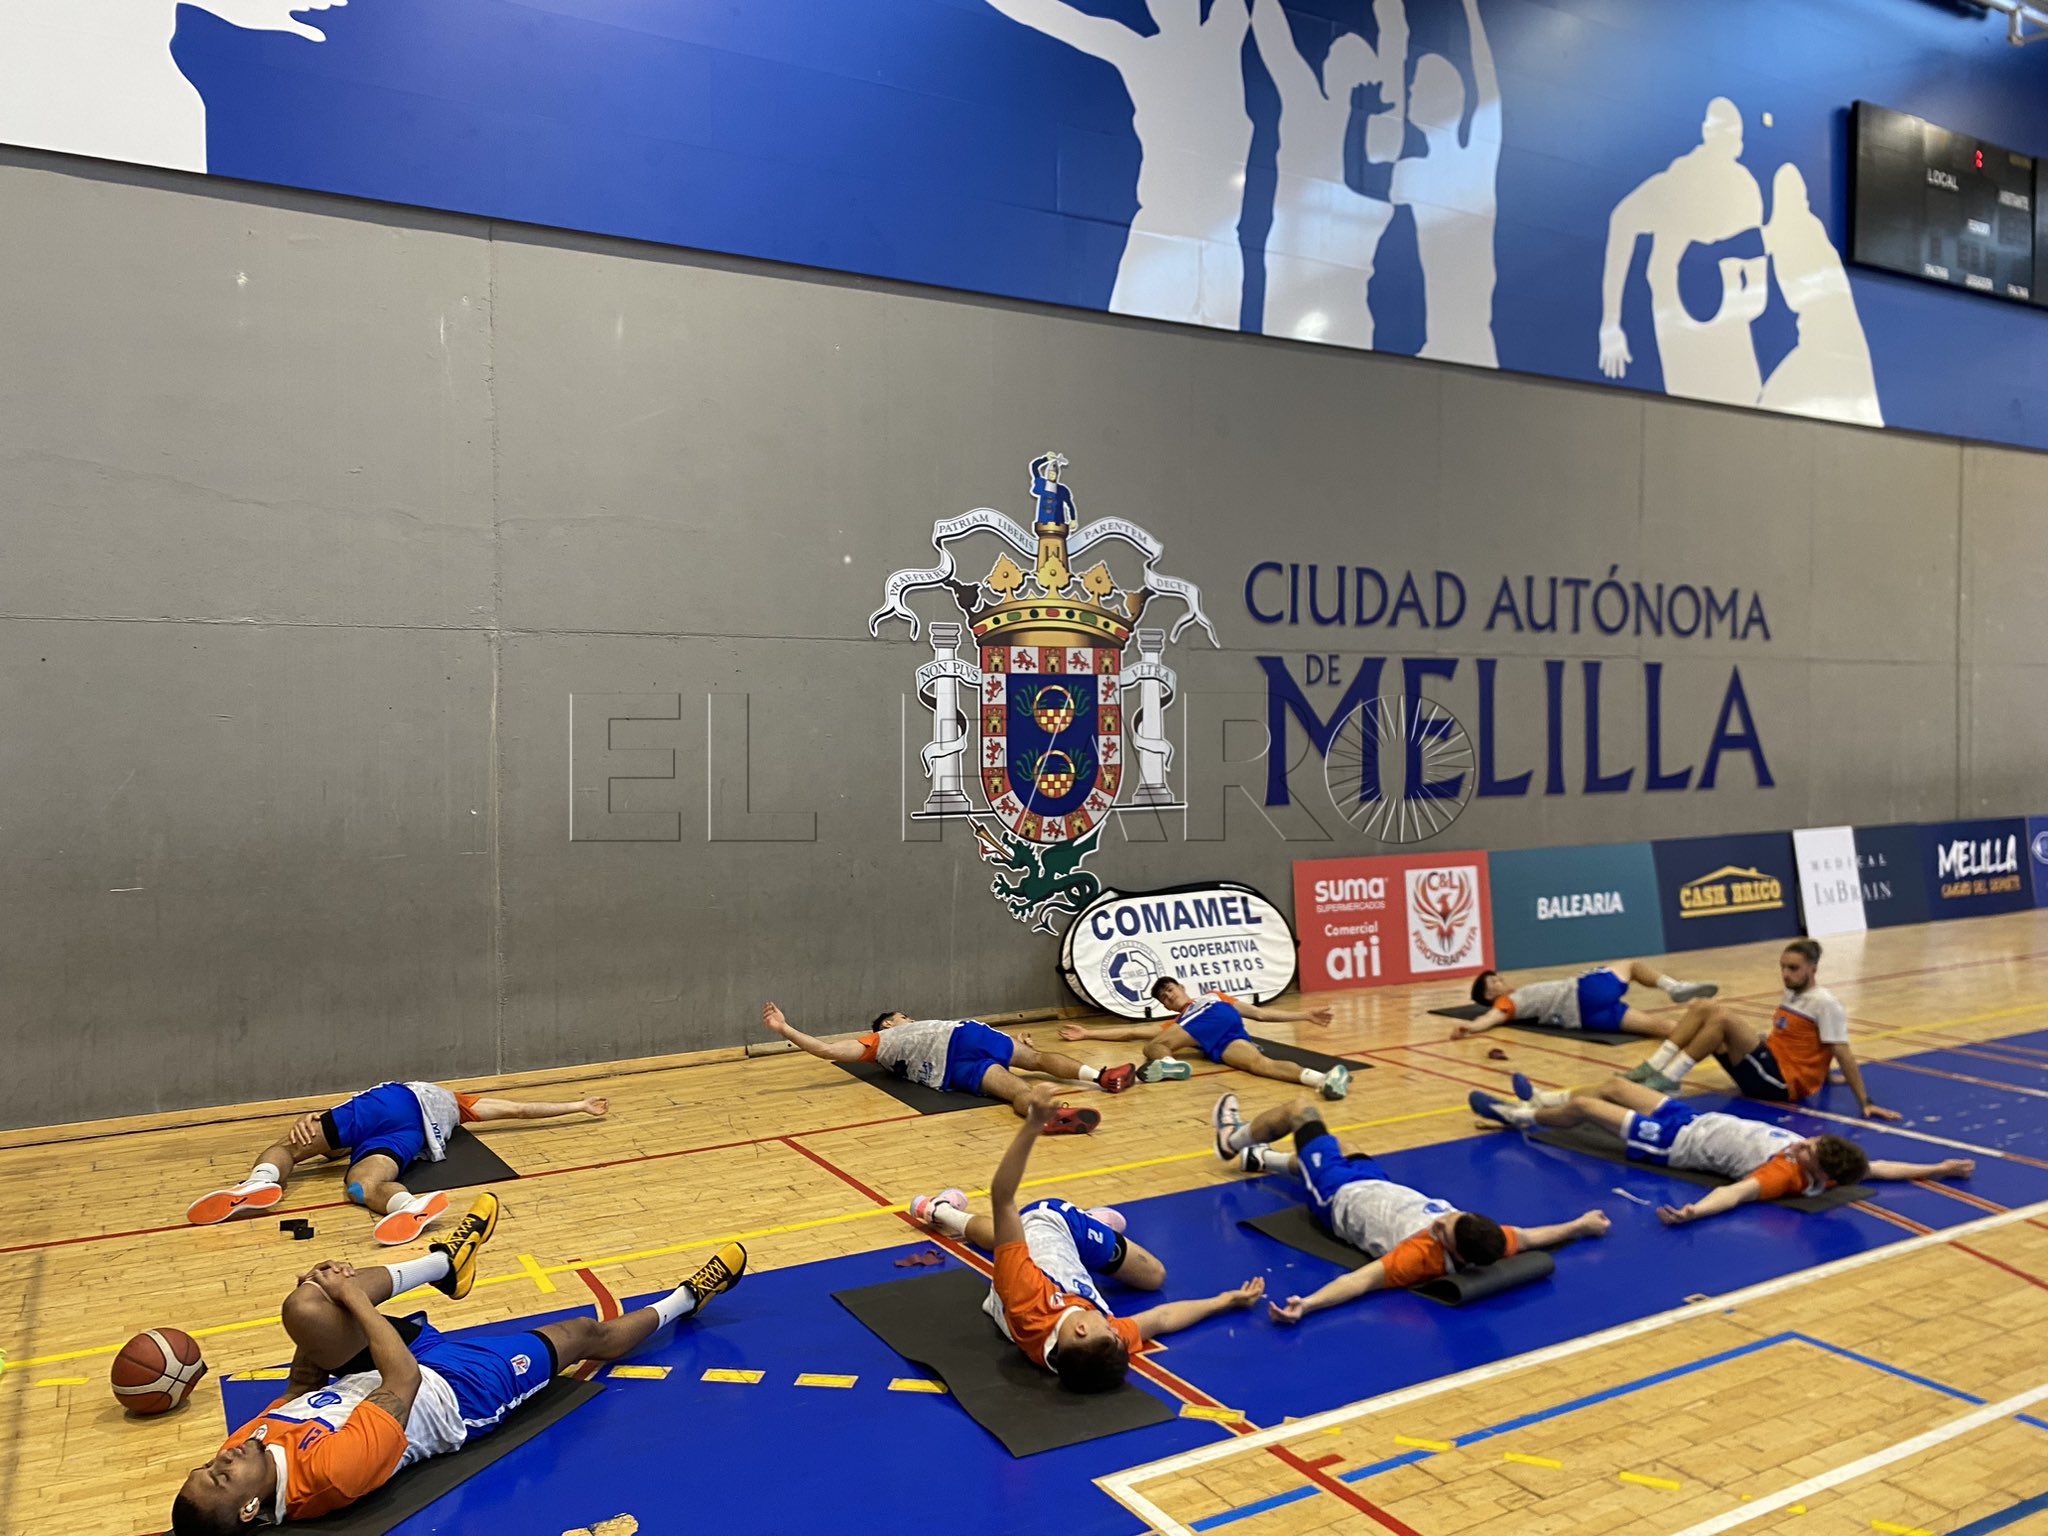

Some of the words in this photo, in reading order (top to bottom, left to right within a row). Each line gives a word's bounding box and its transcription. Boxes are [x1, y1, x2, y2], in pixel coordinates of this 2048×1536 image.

[1926, 168, 1959, 191] LOCAL
[938, 512, 989, 534] PATRIAM
[998, 518, 1034, 551] LIBERIS
[1084, 521, 1148, 545] PARENTEM
[890, 567, 949, 597] PRAEFERRE
[1156, 578, 1191, 593] DECET
[1244, 562, 1467, 629] CIUDAD
[1485, 565, 1772, 640] AUTÓNOMA
[920, 662, 948, 682] NON
[953, 662, 979, 680] PLVS
[1305, 654, 1340, 686] DE
[1256, 655, 1775, 806] MELILLA
[1937, 833, 2018, 880] MELILLA
[1315, 877, 1386, 903] suma
[1680, 884, 1727, 909] CASH
[1731, 878, 1781, 904] BRICO
[1091, 896, 1263, 940] COMAMEL
[1316, 900, 1386, 913] SUPERMERCADOS
[1324, 921, 1379, 937] Comercial
[1171, 939, 1260, 960] COOPERATIVA
[1326, 935, 1381, 980] ati
[1412, 926, 1478, 967] FISIOTERAPEUTA
[1175, 957, 1265, 979] MAESTROS
[1198, 977, 1253, 995] MELILLA
